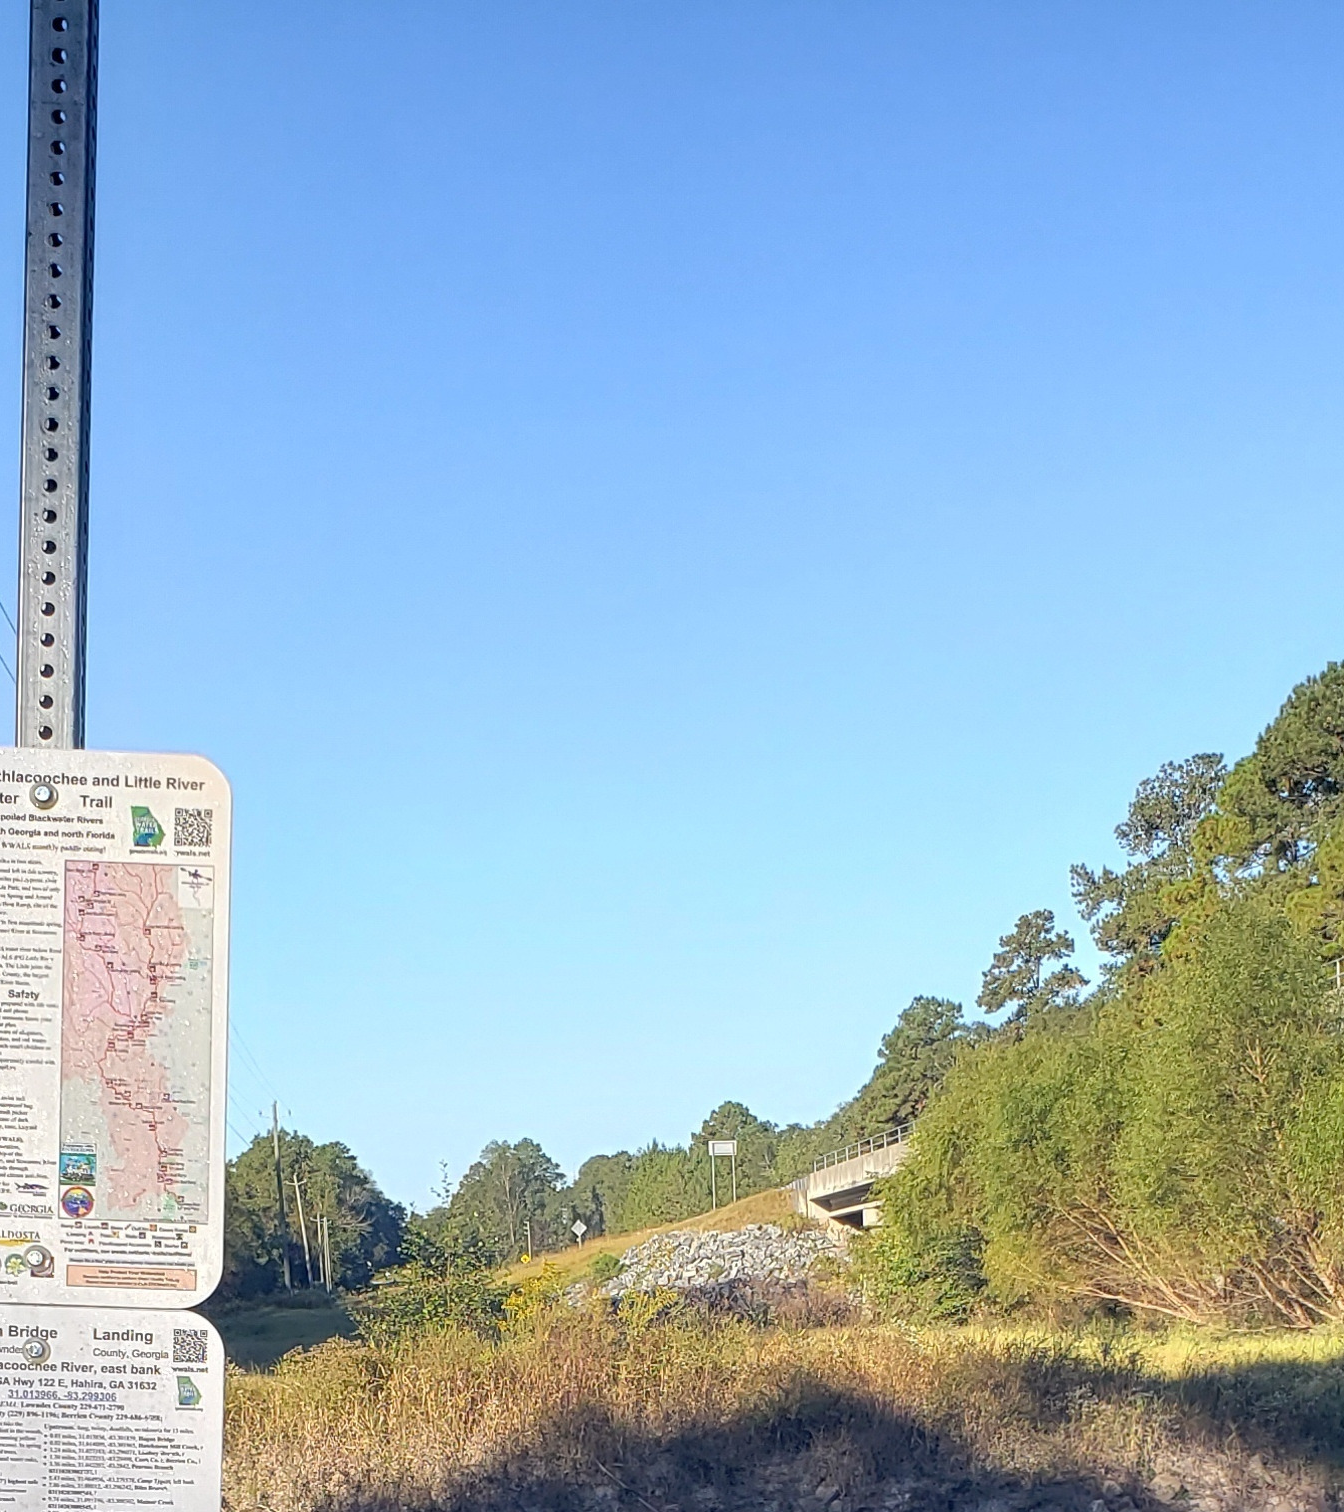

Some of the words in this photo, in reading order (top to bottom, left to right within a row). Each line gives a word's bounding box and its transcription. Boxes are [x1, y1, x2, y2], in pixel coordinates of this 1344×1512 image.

[92, 775, 120, 788] and
[125, 775, 161, 789] Little
[166, 777, 206, 791] River
[80, 795, 113, 809] Trail
[28, 814, 75, 824] Blackwater
[77, 816, 104, 825] Rivers
[8, 828, 41, 838] Georgia
[43, 830, 59, 838] and
[61, 831, 84, 839] north
[86, 831, 115, 840] Florida
[8, 990, 40, 1001] Safety
[10, 1203, 54, 1214] GEORGIA
[8, 1325, 58, 1340] Bridge
[93, 1328, 153, 1344] Landing
[93, 1348, 129, 1360] County,
[132, 1349, 169, 1360] Georgia
[61, 1362, 97, 1375] River,
[101, 1365, 127, 1374] east
[131, 1364, 161, 1375] bank
[13, 1377, 35, 1388] Hwy
[38, 1378, 55, 1387] 122
[58, 1379, 68, 1388] E,
[71, 1379, 106, 1389] Hahira,
[109, 1380, 125, 1389] GA
[127, 1381, 157, 1390] 31632
[64, 1392, 117, 1402] -83.299306
